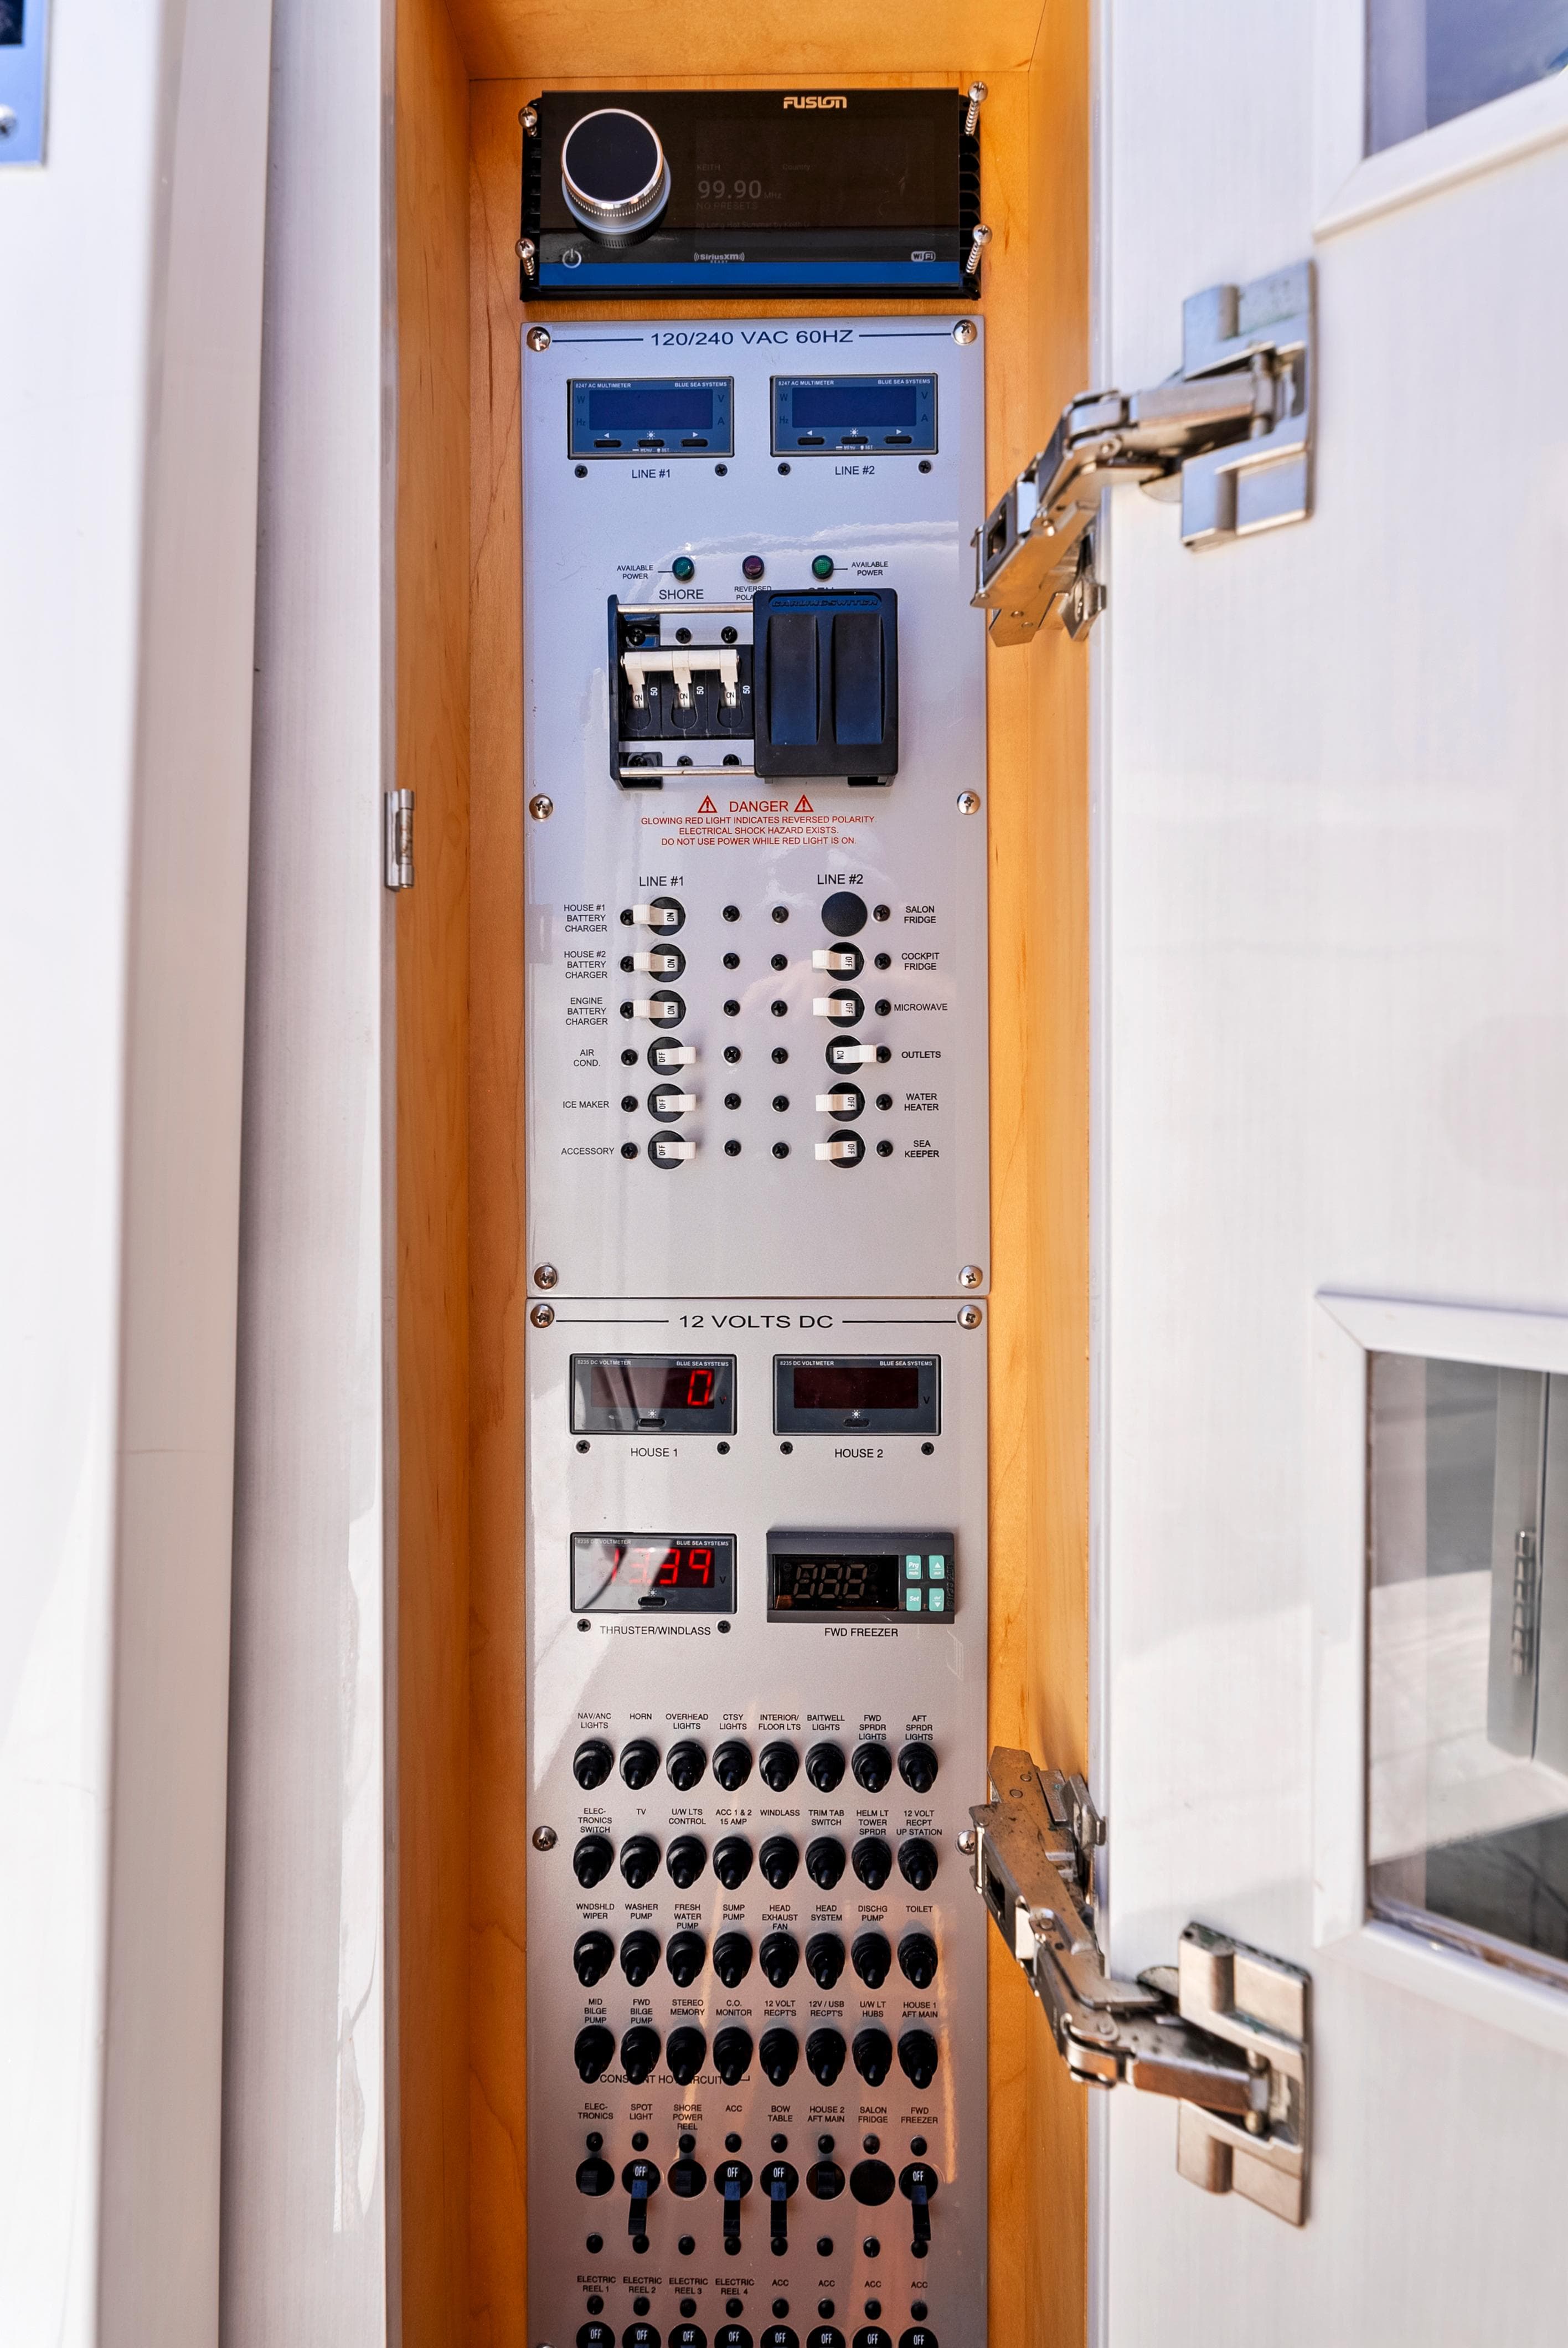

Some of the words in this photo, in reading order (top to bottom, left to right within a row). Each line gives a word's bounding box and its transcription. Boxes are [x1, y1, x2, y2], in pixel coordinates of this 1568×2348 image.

[784, 96, 847, 109] FUSION
[698, 180, 761, 199] 99.90
[652, 332, 733, 346] 120/240
[741, 331, 788, 344] VAC
[796, 330, 853, 343] 60HZ
[632, 470, 656, 478] LINE
[659, 469, 670, 477] #1
[835, 466, 859, 475] LINE
[863, 466, 874, 475] #2
[659, 589, 704, 600] SHORE
[730, 801, 788, 812] DANGER
[639, 876, 667, 886] LINE
[670, 876, 683, 886] #1
[818, 874, 845, 884] LINE
[849, 874, 863, 884] #2
[668, 912, 674, 921] ON
[837, 1051, 844, 1060] ON
[680, 1316, 704, 1327] 12
[711, 1316, 790, 1328] VOLTS
[800, 1316, 833, 1328] DC
[688, 1371, 712, 1405] 0
[631, 1448, 669, 1456] HOUSE
[835, 1449, 874, 1458] HOUSE
[877, 1449, 883, 1458] 2
[601, 1626, 710, 1635] THRUSTER/WINDLASS
[825, 1628, 847, 1636] FWD
[851, 1628, 898, 1636] FREEZER
[635, 2166, 646, 2176] OFF
[914, 2335, 924, 2345] OFF
